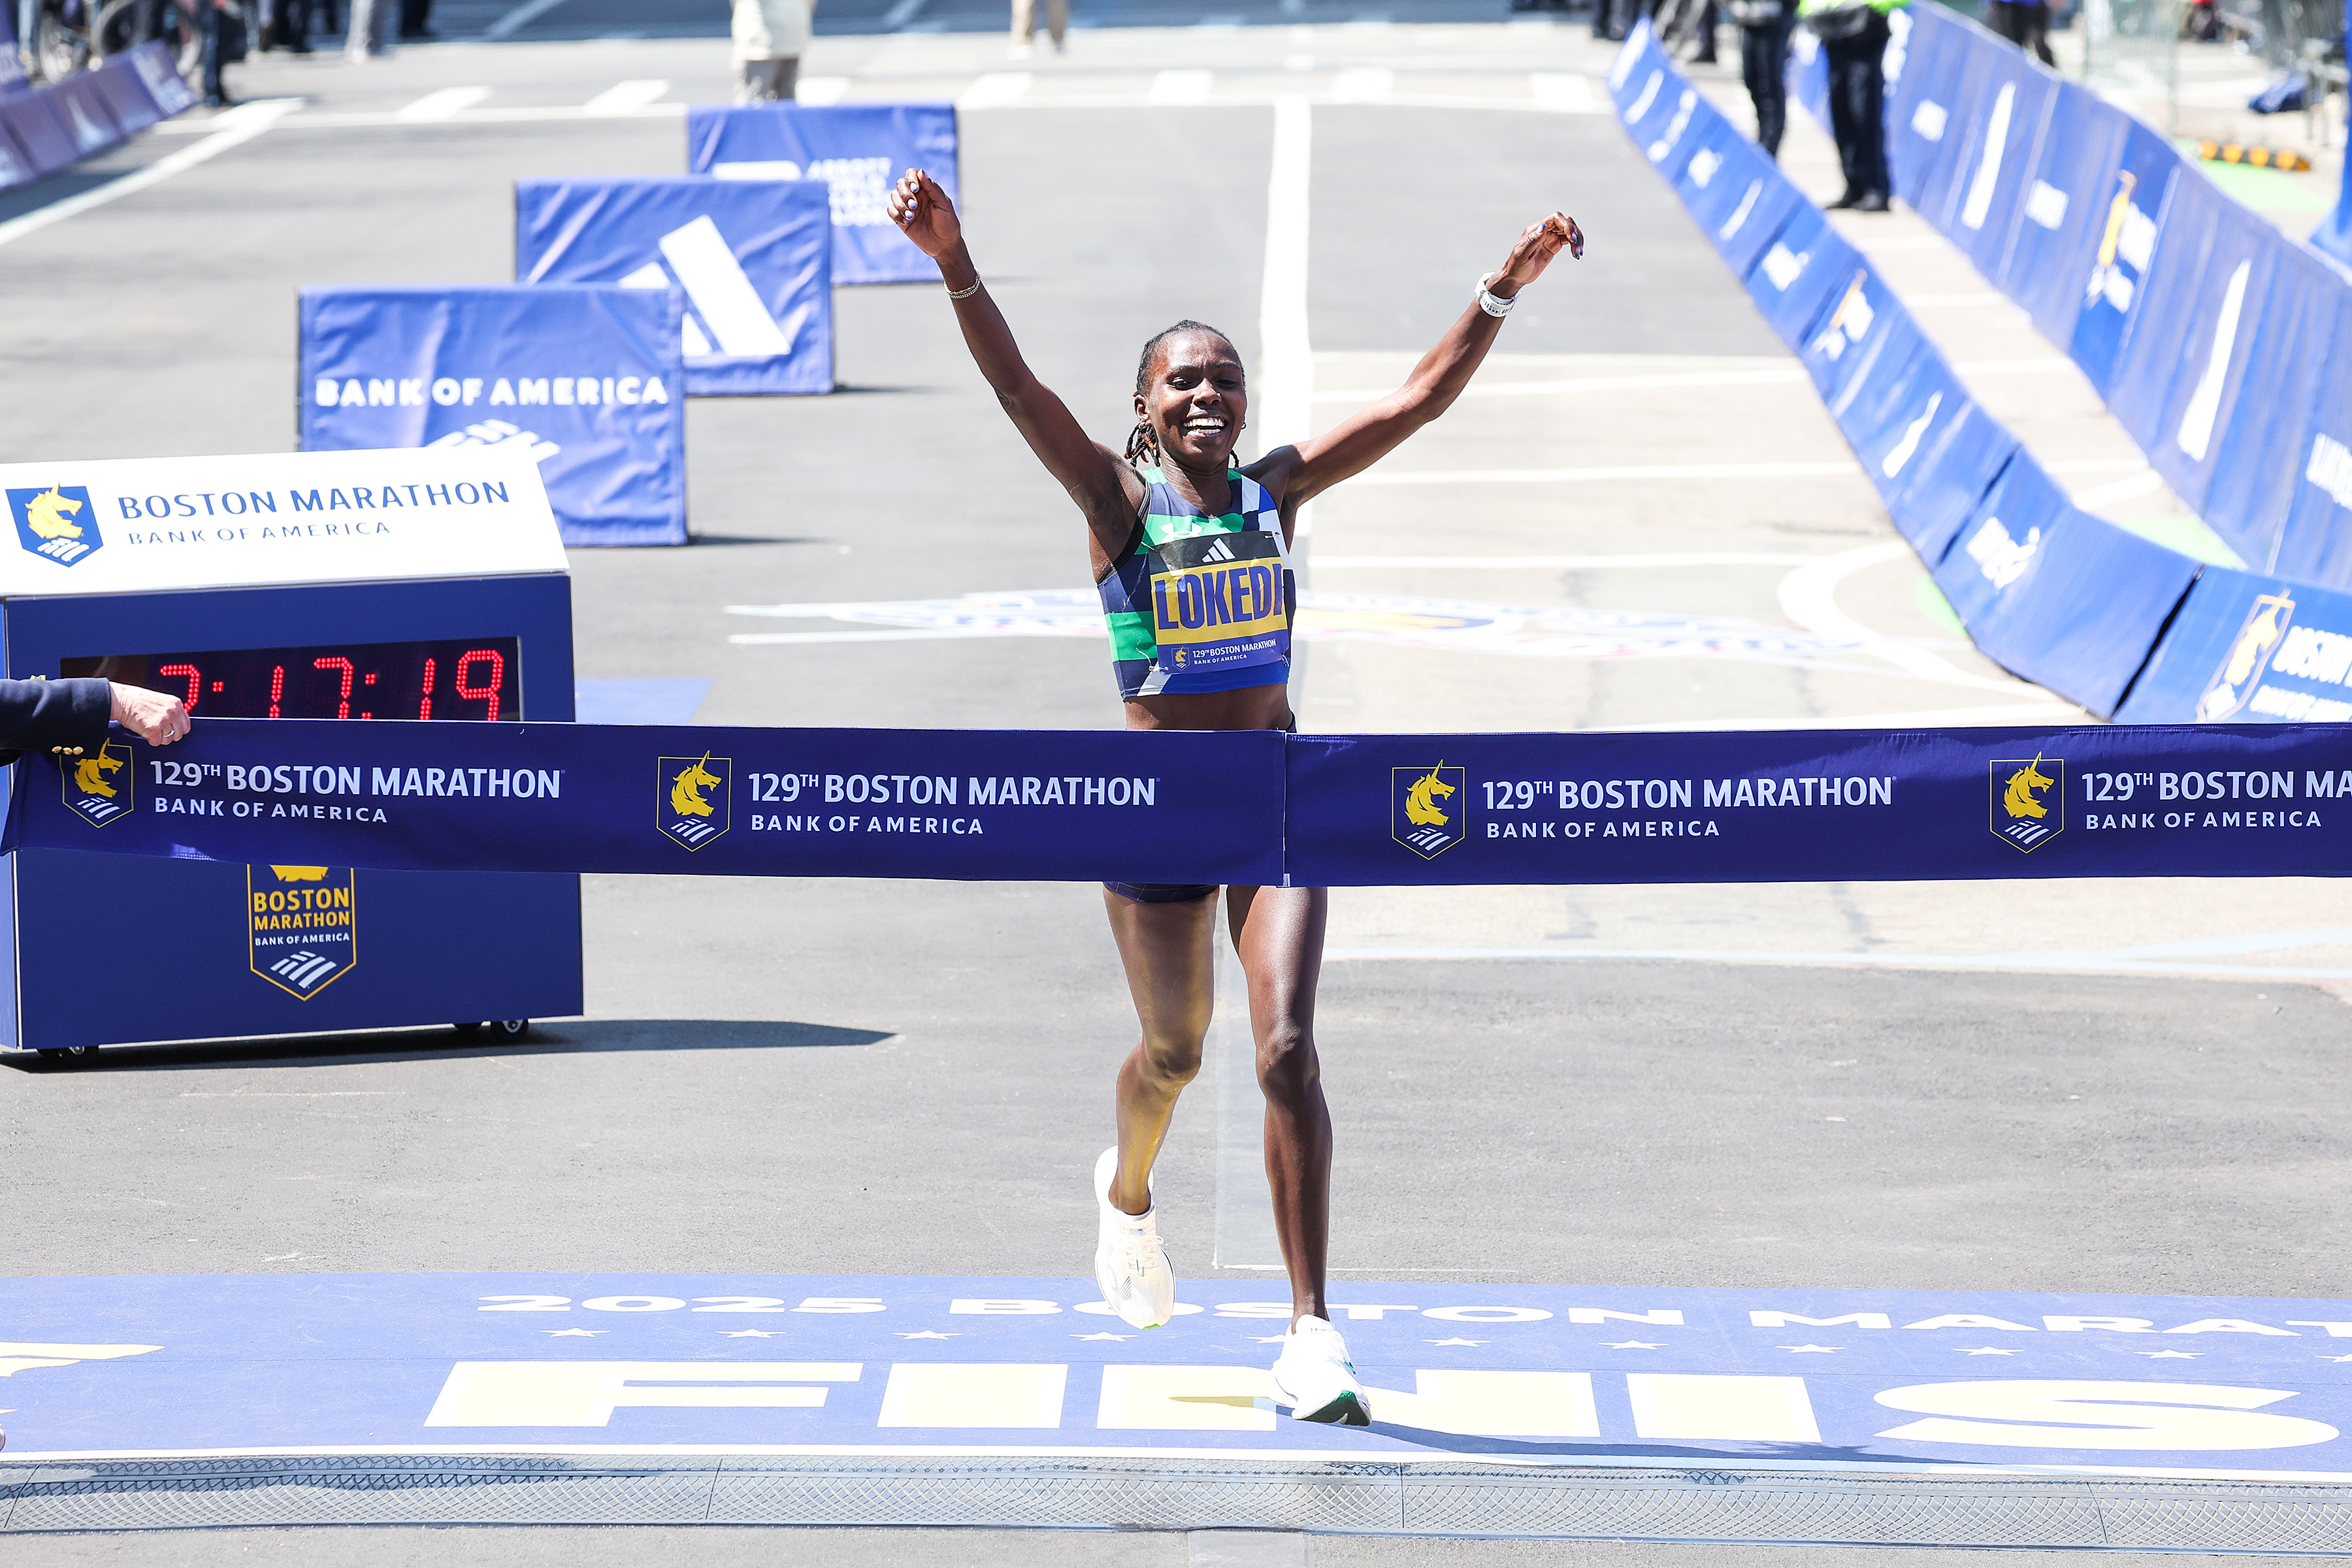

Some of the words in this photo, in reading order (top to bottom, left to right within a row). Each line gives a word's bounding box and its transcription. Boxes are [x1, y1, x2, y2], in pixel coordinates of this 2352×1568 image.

[316, 376, 428, 408] BANK
[433, 378, 483, 405] OF
[490, 376, 668, 408] AMERICA
[118, 491, 276, 519] BOSTON
[290, 482, 509, 512] MARATHON
[129, 531, 204, 544] BANK
[218, 529, 250, 540] OF
[263, 523, 389, 538] AMERICA
[1154, 563, 1283, 630] LOKEDI
[1210, 645, 1240, 657] BOSTON
[1242, 638, 1277, 653] MARATHON
[1220, 653, 1248, 663] AMERICA
[150, 761, 220, 786] 129TH
[227, 766, 360, 794] BOSTON
[372, 768, 559, 798] MARATHON
[749, 774, 818, 802] 129TH
[825, 775, 956, 804] BOSTON
[969, 777, 1154, 805] MARATHON
[2082, 773, 2153, 800] 129TH
[2160, 772, 2293, 800] BOSTON
[1483, 781, 1552, 809] 129TH
[1560, 780, 1691, 809] BOSTON
[1704, 777, 1891, 807] MARATHON
[155, 798, 223, 816] BANK
[233, 802, 264, 817] OF
[272, 804, 387, 823] AMERICA
[2087, 813, 2155, 829] BANK
[2164, 813, 2195, 827] OF
[2203, 811, 2321, 826] AMERICA
[752, 815, 820, 831] BANK
[829, 816, 860, 832] OF
[867, 817, 983, 834] AMERICA
[1488, 823, 1556, 838] BANK
[1565, 823, 1595, 838] OF
[1603, 821, 1719, 837] AMERICA
[254, 887, 349, 913] BOSTON
[255, 911, 349, 930] MARATHON
[255, 937, 284, 945] BANK
[286, 936, 299, 944] OF
[302, 933, 349, 943] AMERICA
[478, 1296, 887, 1313] 2025
[423, 1361, 2340, 1451] FINIS
